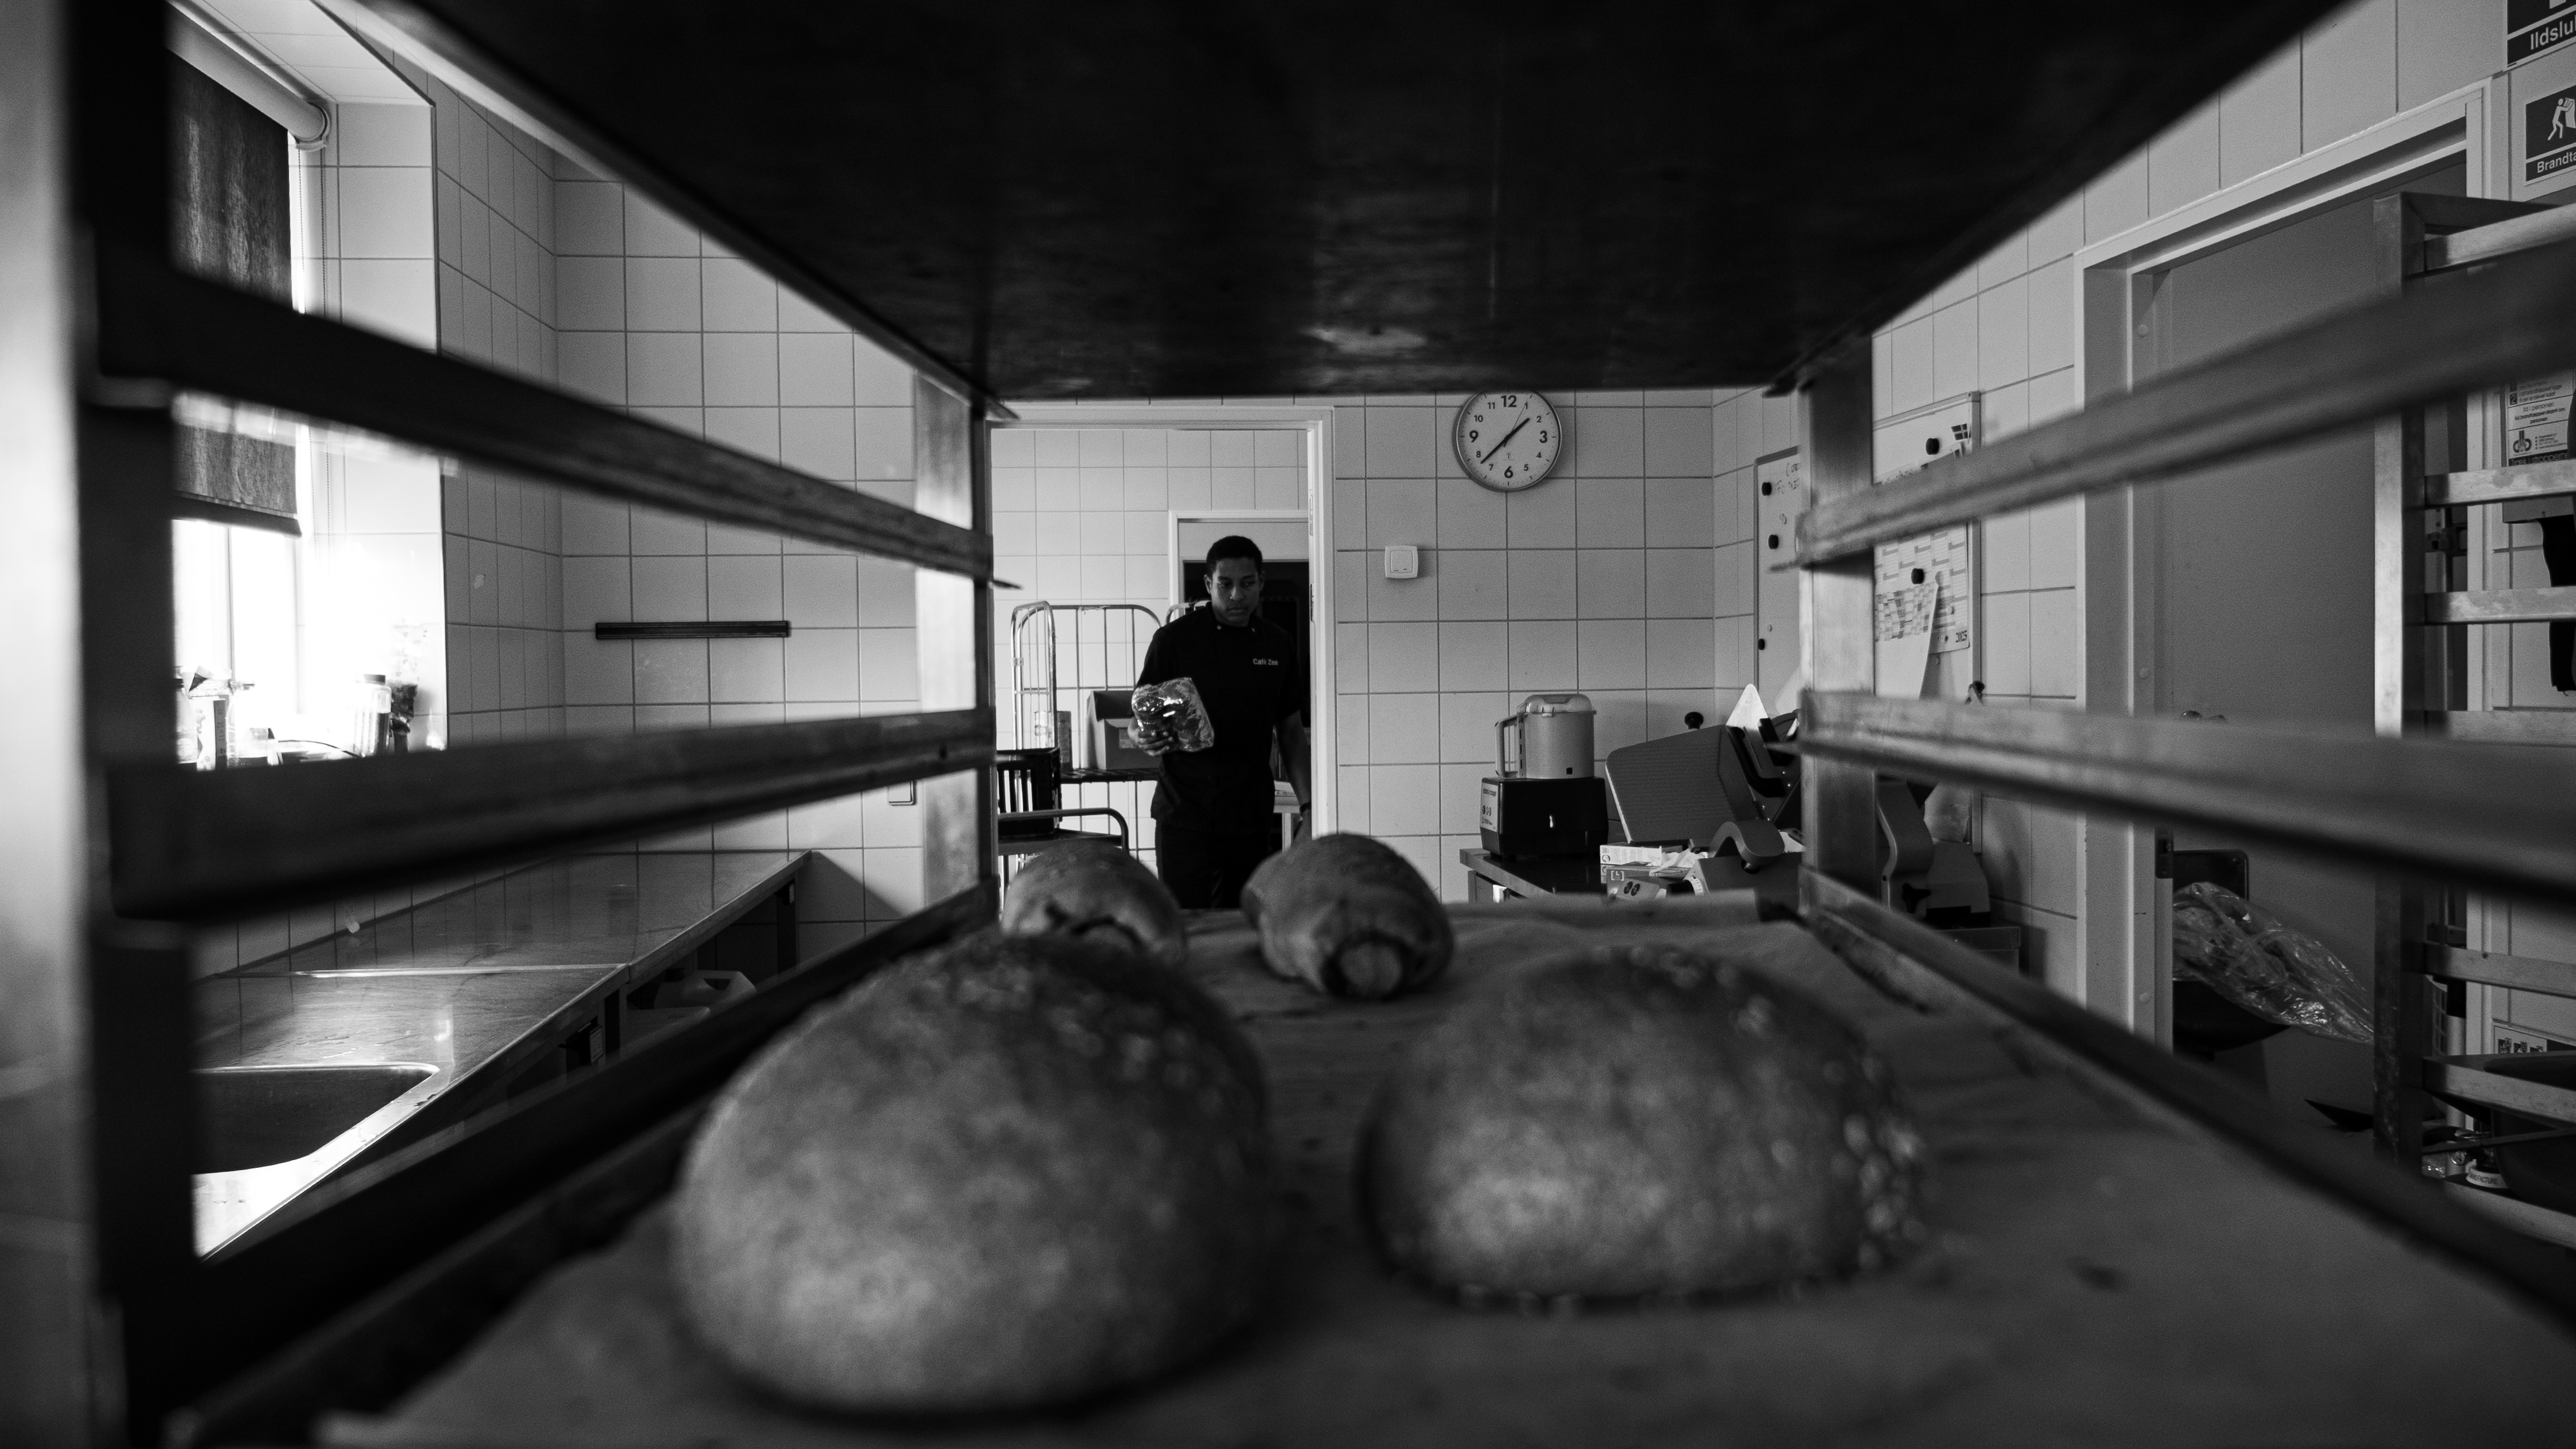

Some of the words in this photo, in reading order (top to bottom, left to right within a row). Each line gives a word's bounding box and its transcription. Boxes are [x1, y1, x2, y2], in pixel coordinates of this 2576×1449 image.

[2530, 14, 2576, 50] Ildslu
[1500, 395, 1517, 408] 12
[2511, 394, 2516, 404] 2
[1469, 430, 1479, 443] 9
[1539, 430, 1547, 443] 3
[1504, 466, 1513, 479] 6
